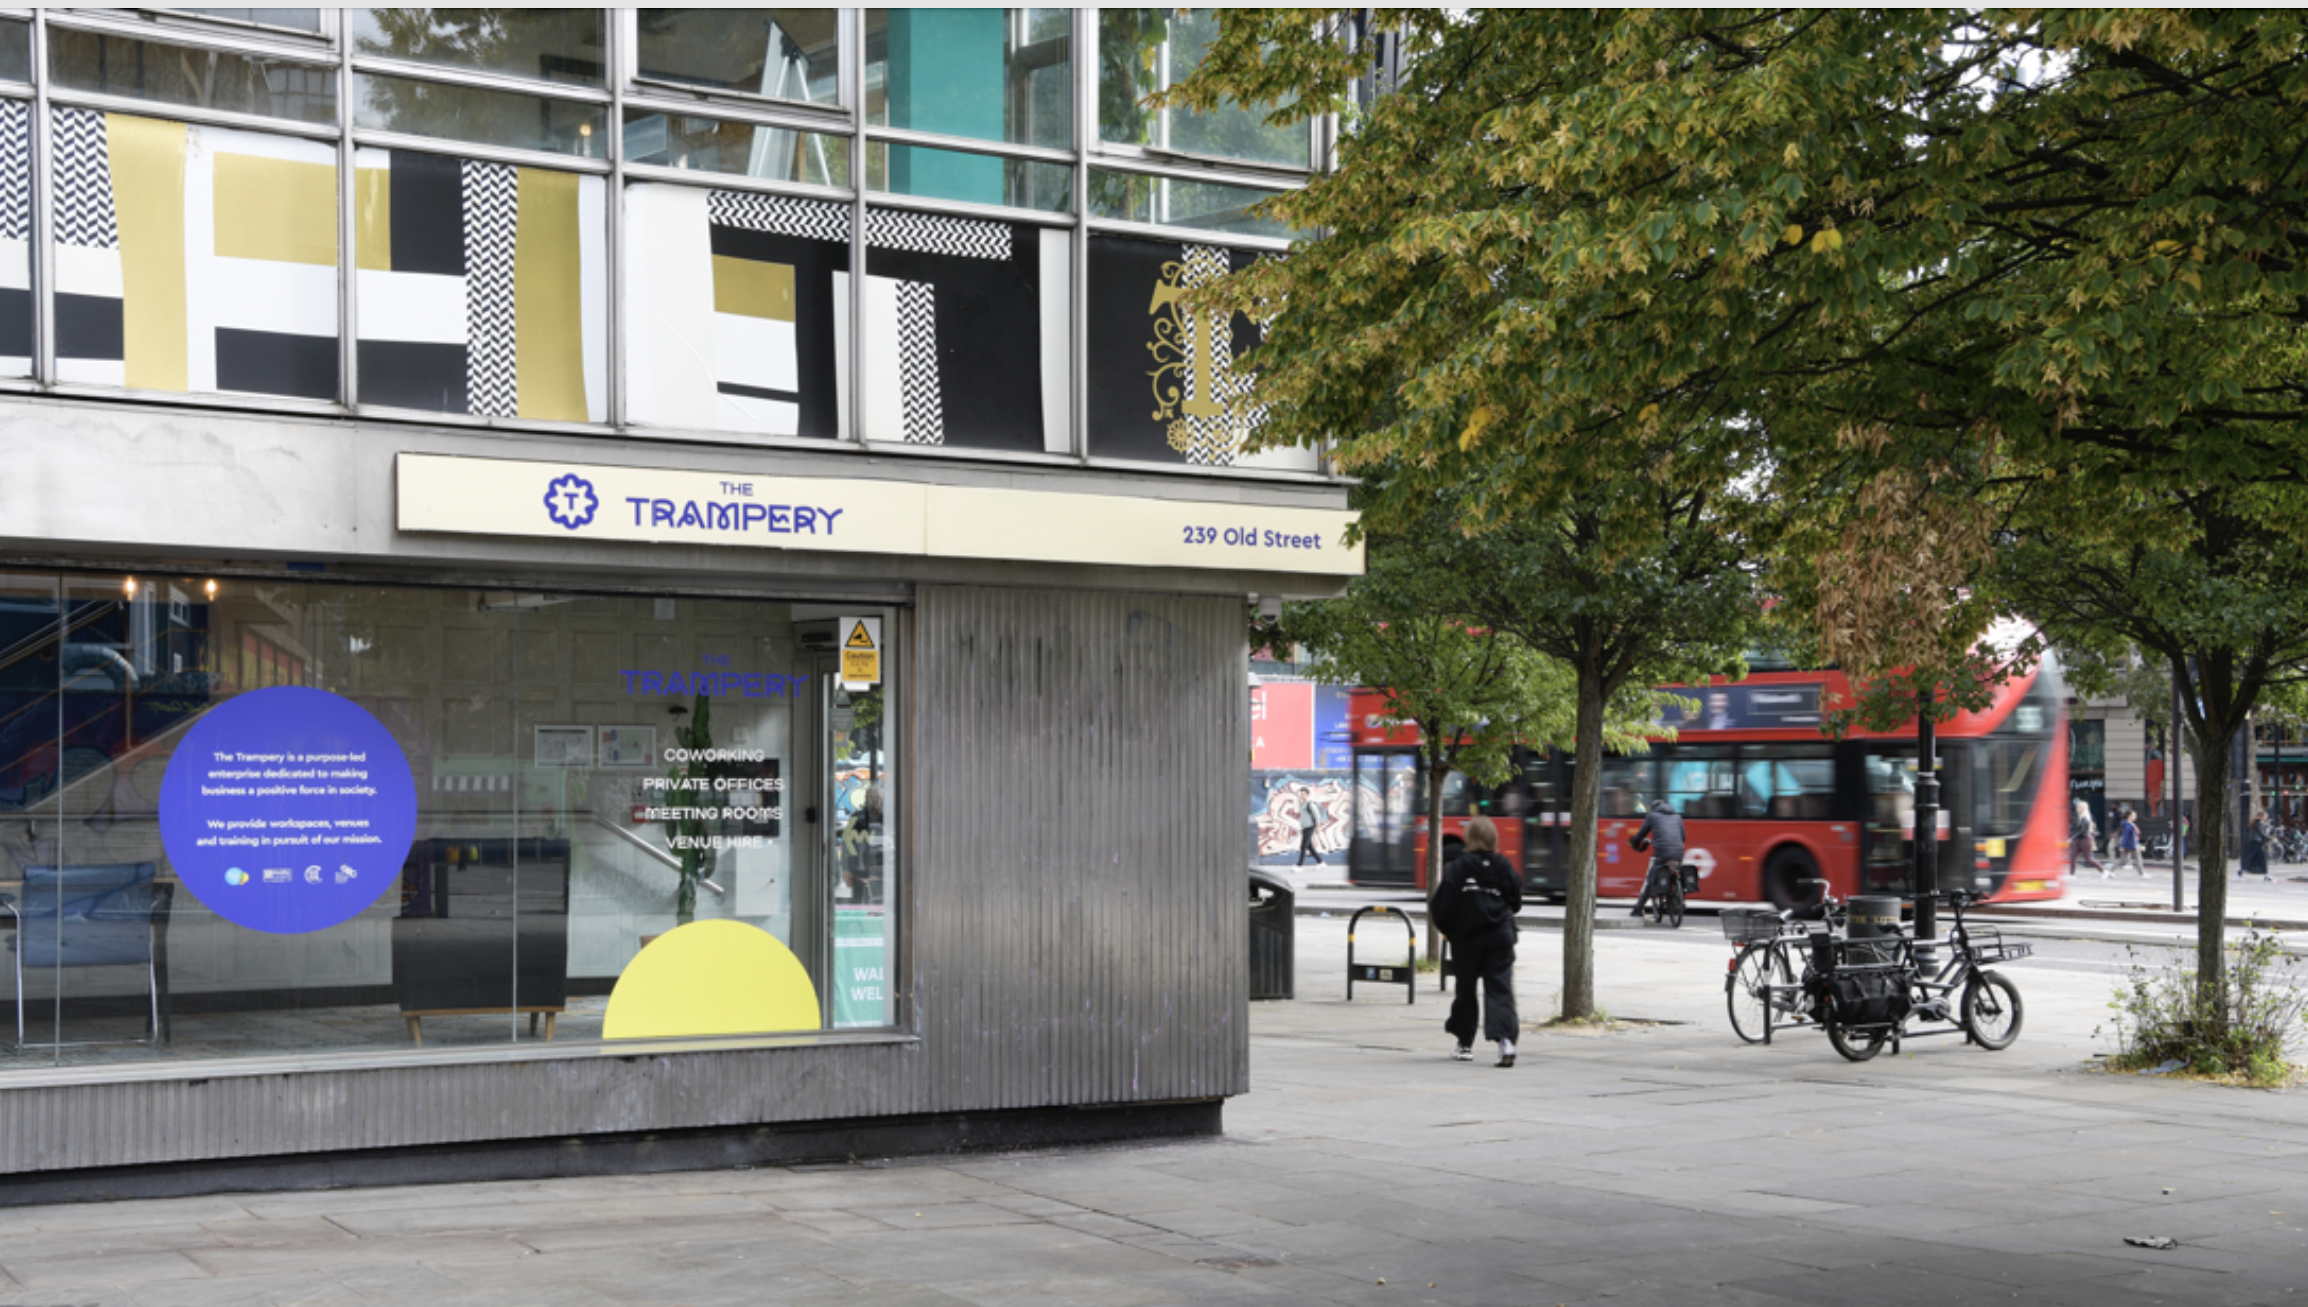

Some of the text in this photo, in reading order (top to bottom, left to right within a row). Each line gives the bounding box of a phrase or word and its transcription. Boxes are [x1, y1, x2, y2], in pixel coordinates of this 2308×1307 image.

[719, 481, 754, 496] THE
[625, 496, 843, 535] TRAMPERY
[1183, 525, 1321, 550] 239 Old Street
[702, 654, 730, 666] THE
[619, 670, 809, 698] TRAMPERY
[213, 752, 366, 763] The Trampery is a purpose-led
[664, 748, 765, 762] COWORKING
[208, 768, 368, 780] enterprise dedicated to making
[201, 784, 378, 796] business a positive force in society.
[643, 778, 785, 790] PRIVATE OFFICES
[645, 807, 784, 820] MEETING ROOMS
[207, 819, 370, 830] We provide workspaces, venues
[196, 834, 382, 847] and training in pursuit of our mission.
[666, 836, 763, 849] VENUE HIRE
